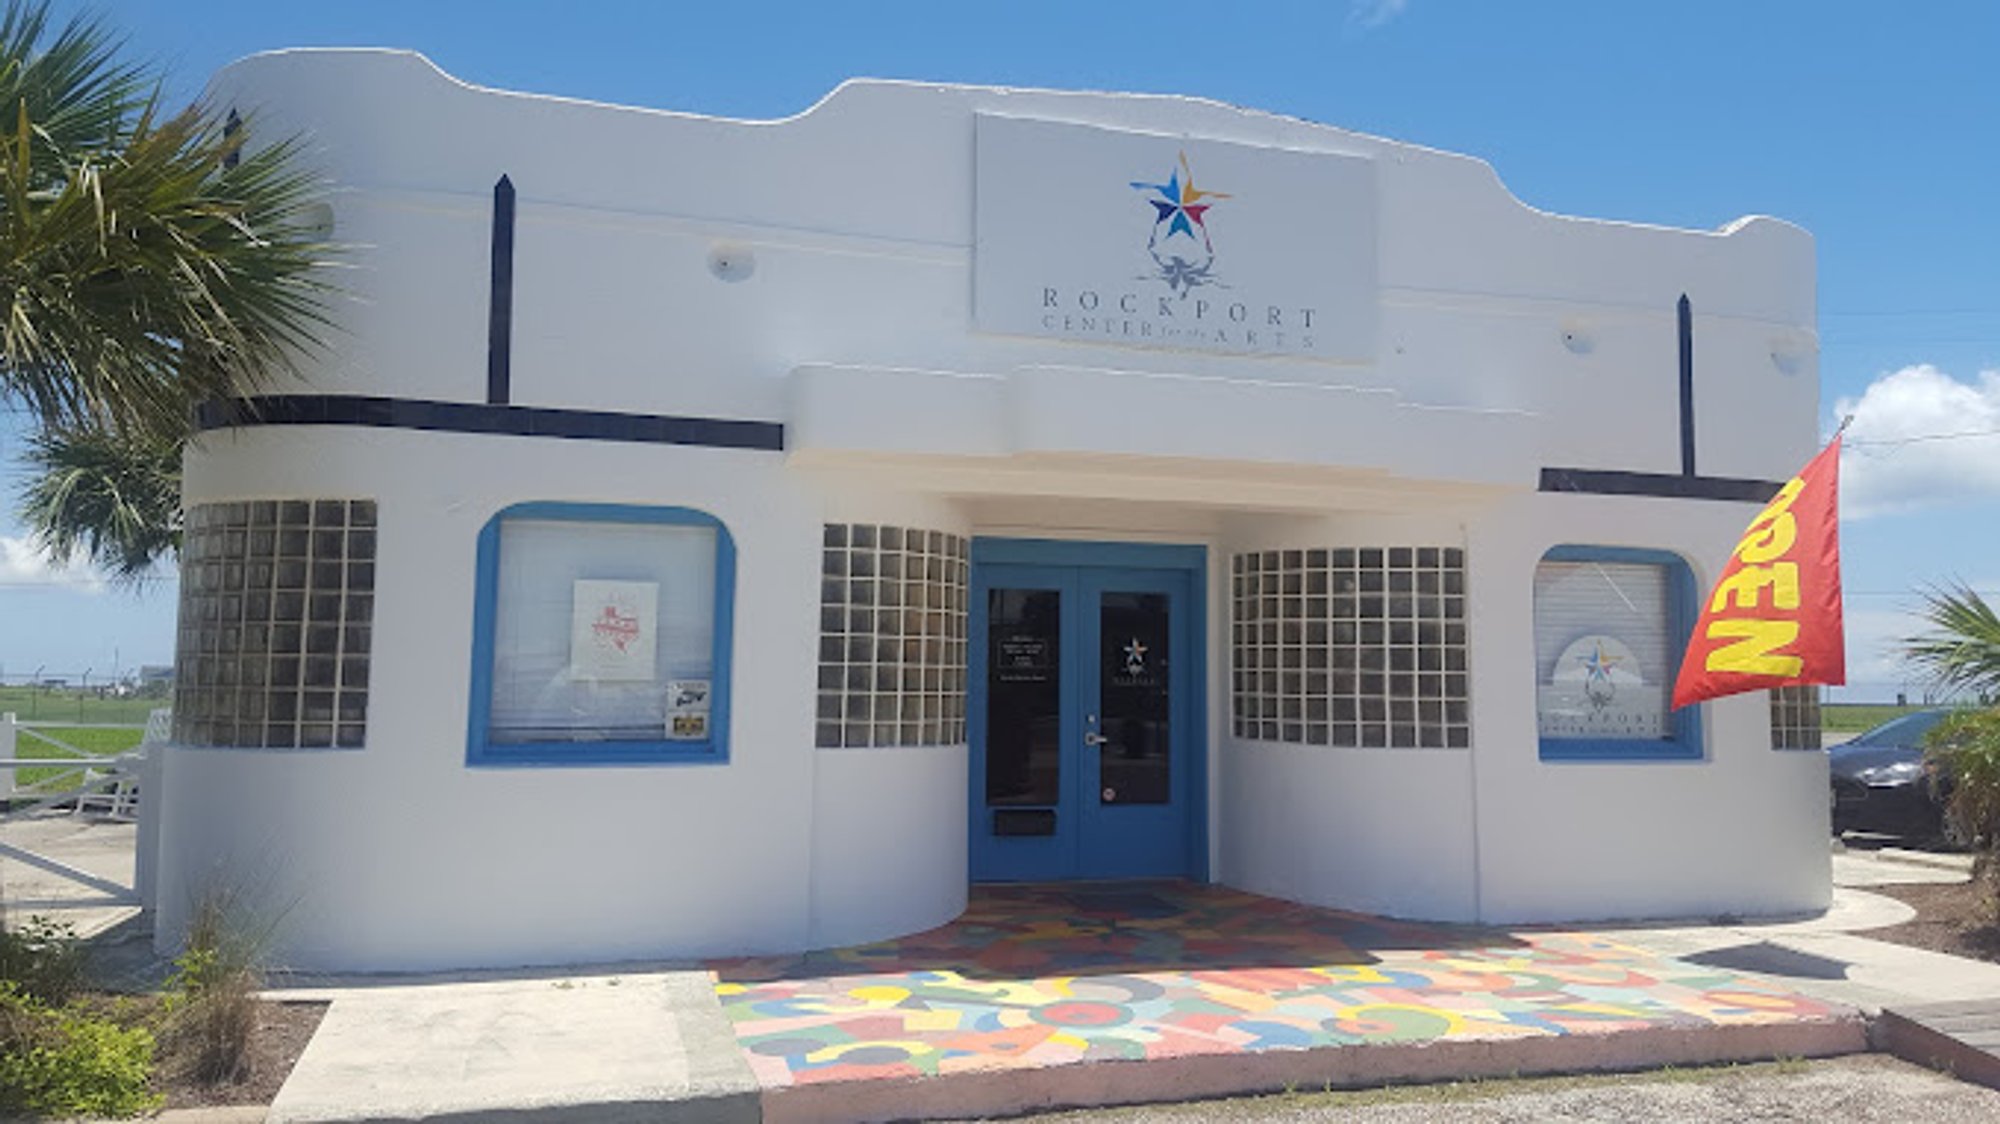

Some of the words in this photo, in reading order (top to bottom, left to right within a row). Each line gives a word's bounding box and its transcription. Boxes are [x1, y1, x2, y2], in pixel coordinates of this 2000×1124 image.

[1042, 287, 1316, 328] ROCKPORT
[1041, 315, 1153, 337] CENTER
[1214, 329, 1314, 348] ARTS
